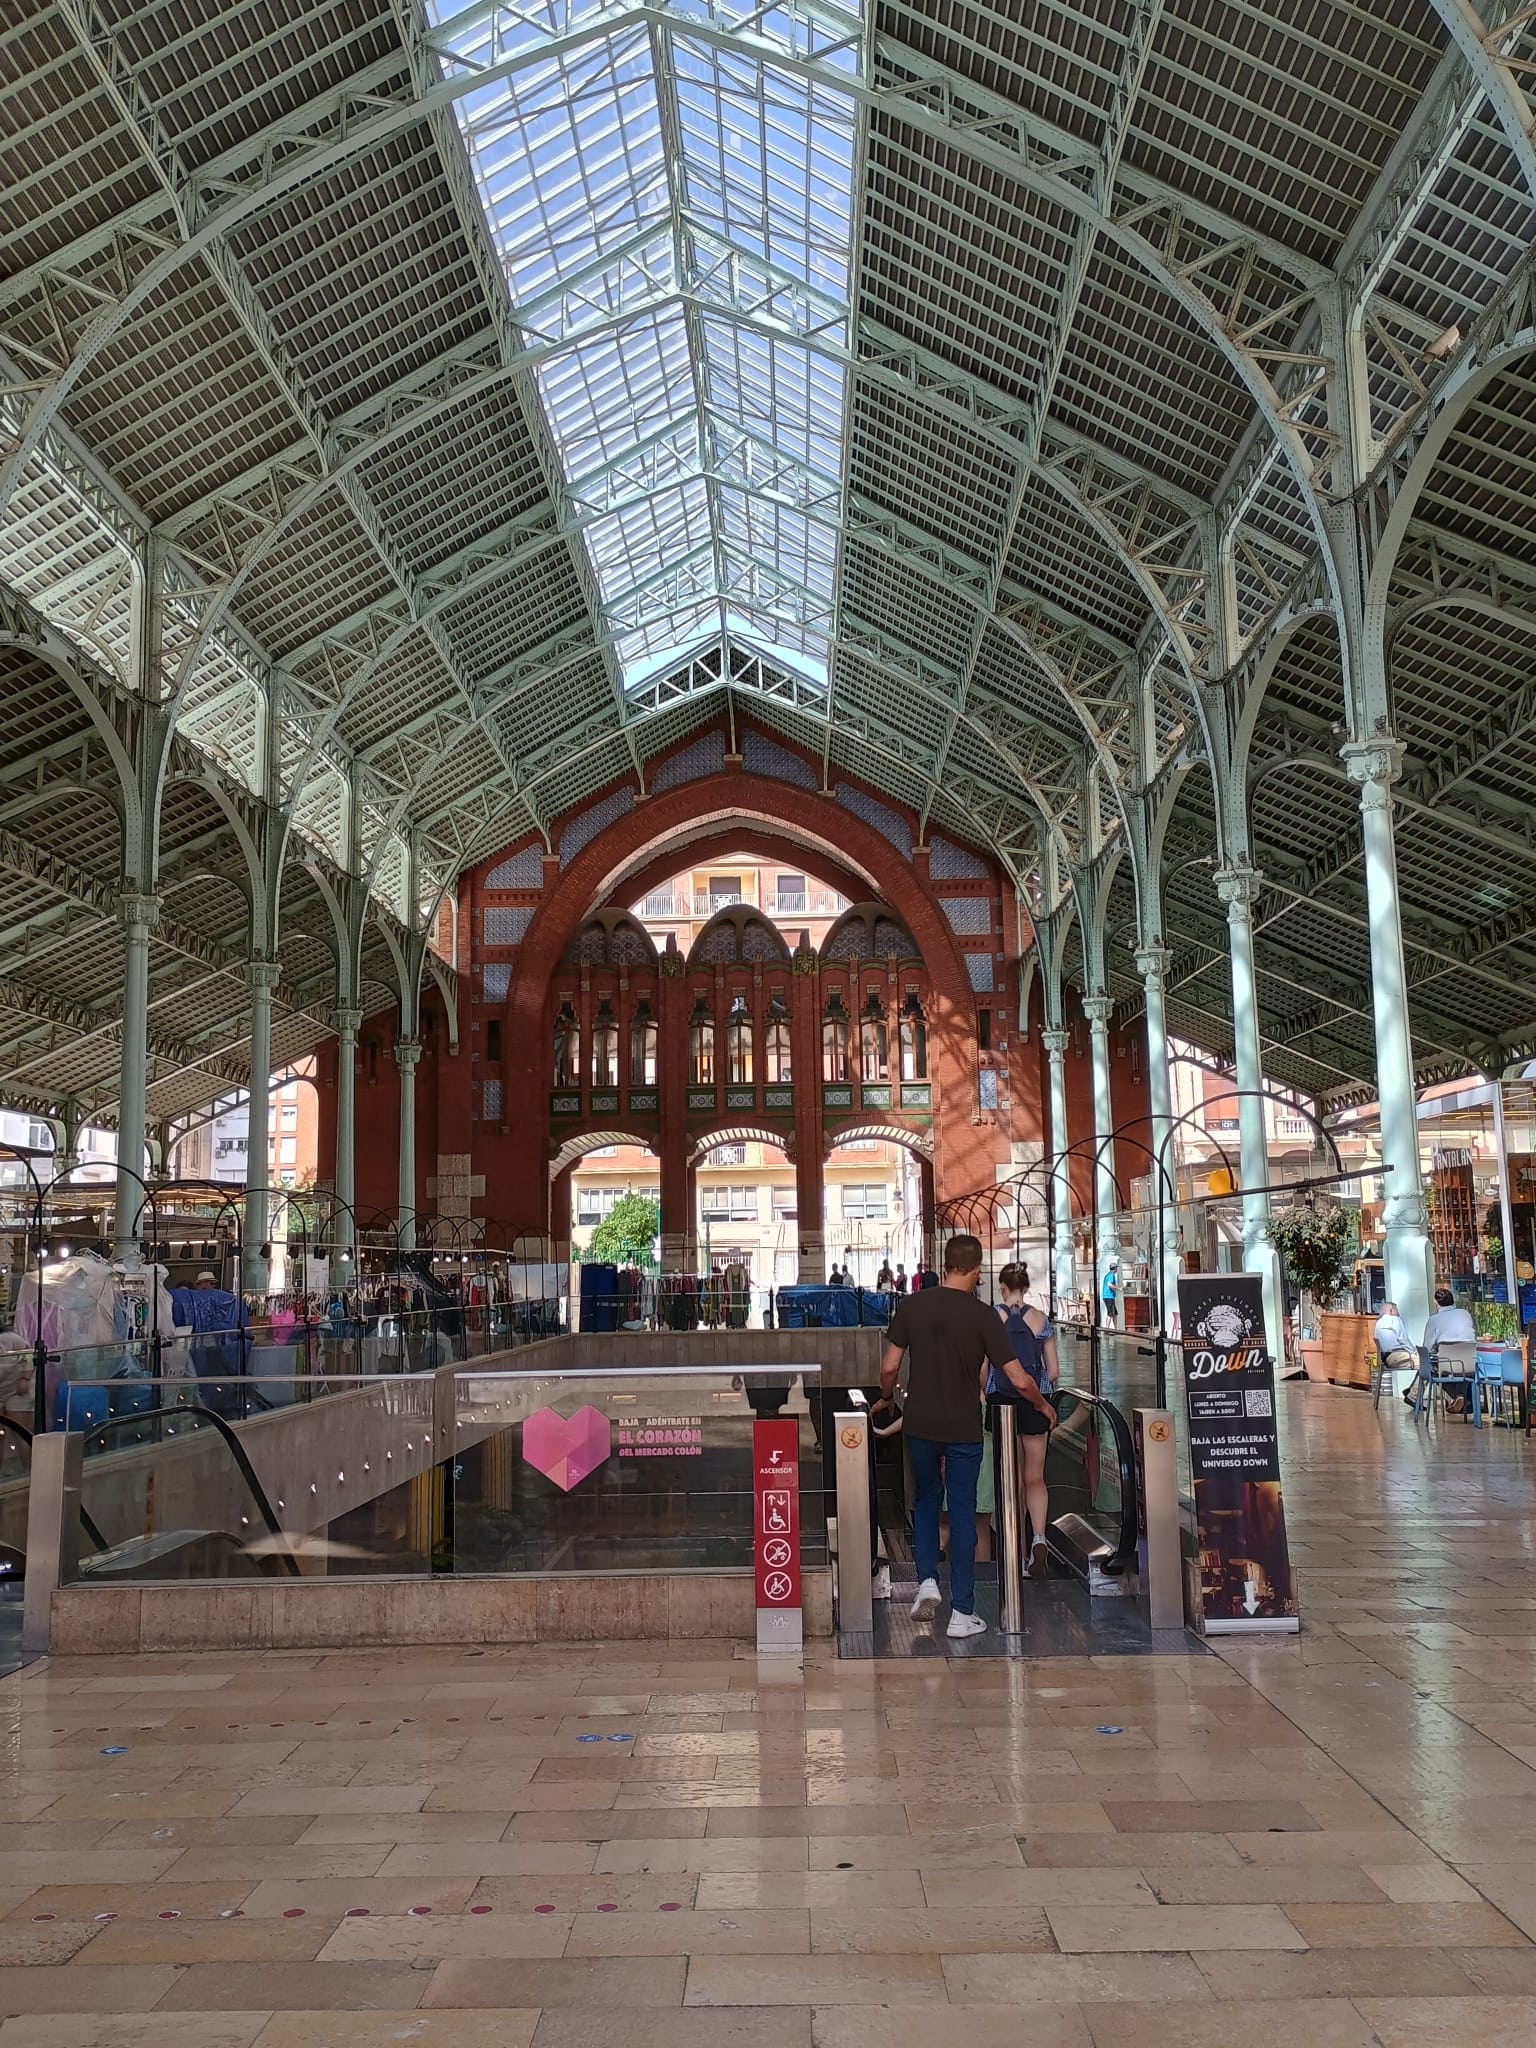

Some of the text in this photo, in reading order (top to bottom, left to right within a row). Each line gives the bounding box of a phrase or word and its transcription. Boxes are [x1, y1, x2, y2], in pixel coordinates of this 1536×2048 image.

[1189, 1348, 1263, 1379] Down
[618, 1416, 702, 1426] BAJA ADÉNTRATE EN
[618, 1426, 702, 1444] EL CORAZÓN
[1191, 1434, 1275, 1445] BAJA LAS ESCALERAS Y
[618, 1445, 702, 1457] DEL MERCADO COLÓN
[1210, 1446, 1258, 1456] DESCUBRE EL
[1202, 1458, 1268, 1468] UNIVERSO DOWN
